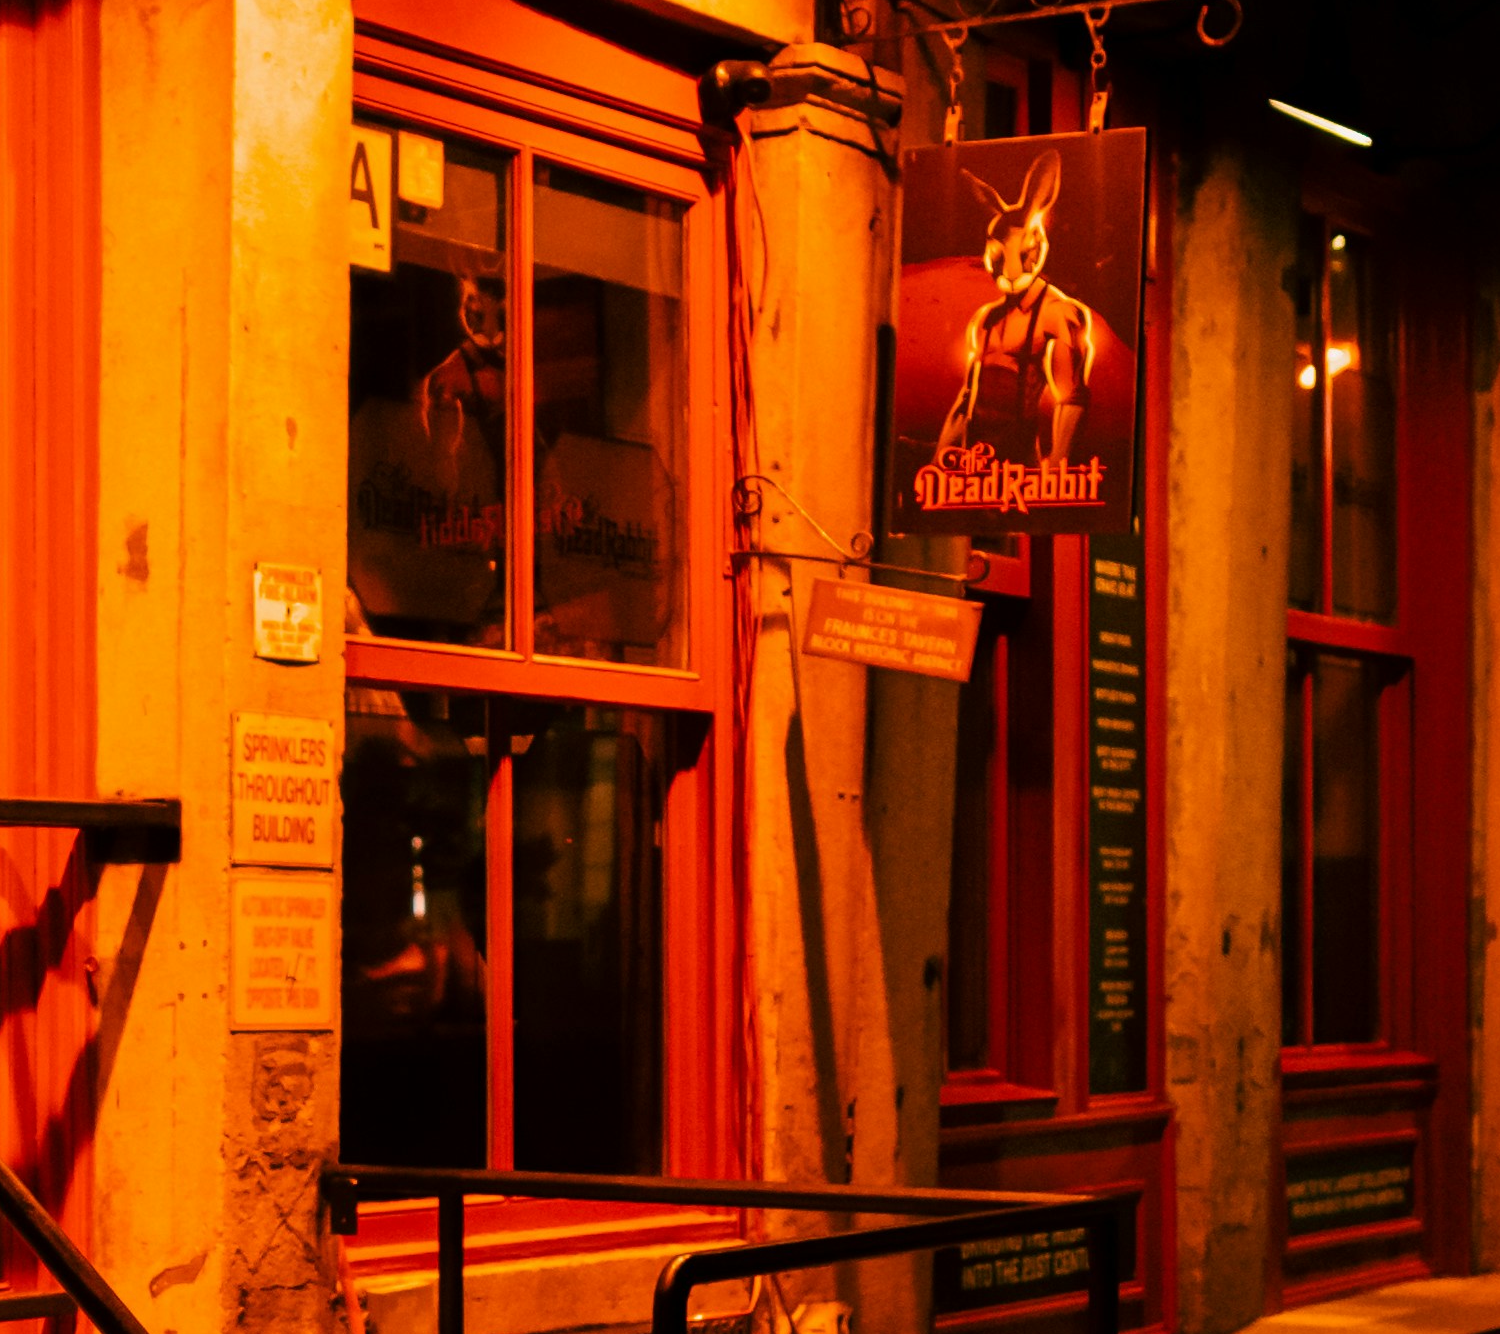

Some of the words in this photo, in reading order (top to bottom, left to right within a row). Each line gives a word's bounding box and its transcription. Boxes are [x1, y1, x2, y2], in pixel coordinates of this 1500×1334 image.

[350, 141, 380, 230] A
[914, 457, 1000, 512] Dead
[1000, 455, 1104, 515] Rabbit
[243, 732, 326, 766] SPRINKLERS
[237, 772, 331, 806] THROUGHOUT
[253, 814, 315, 844] BUILDING
